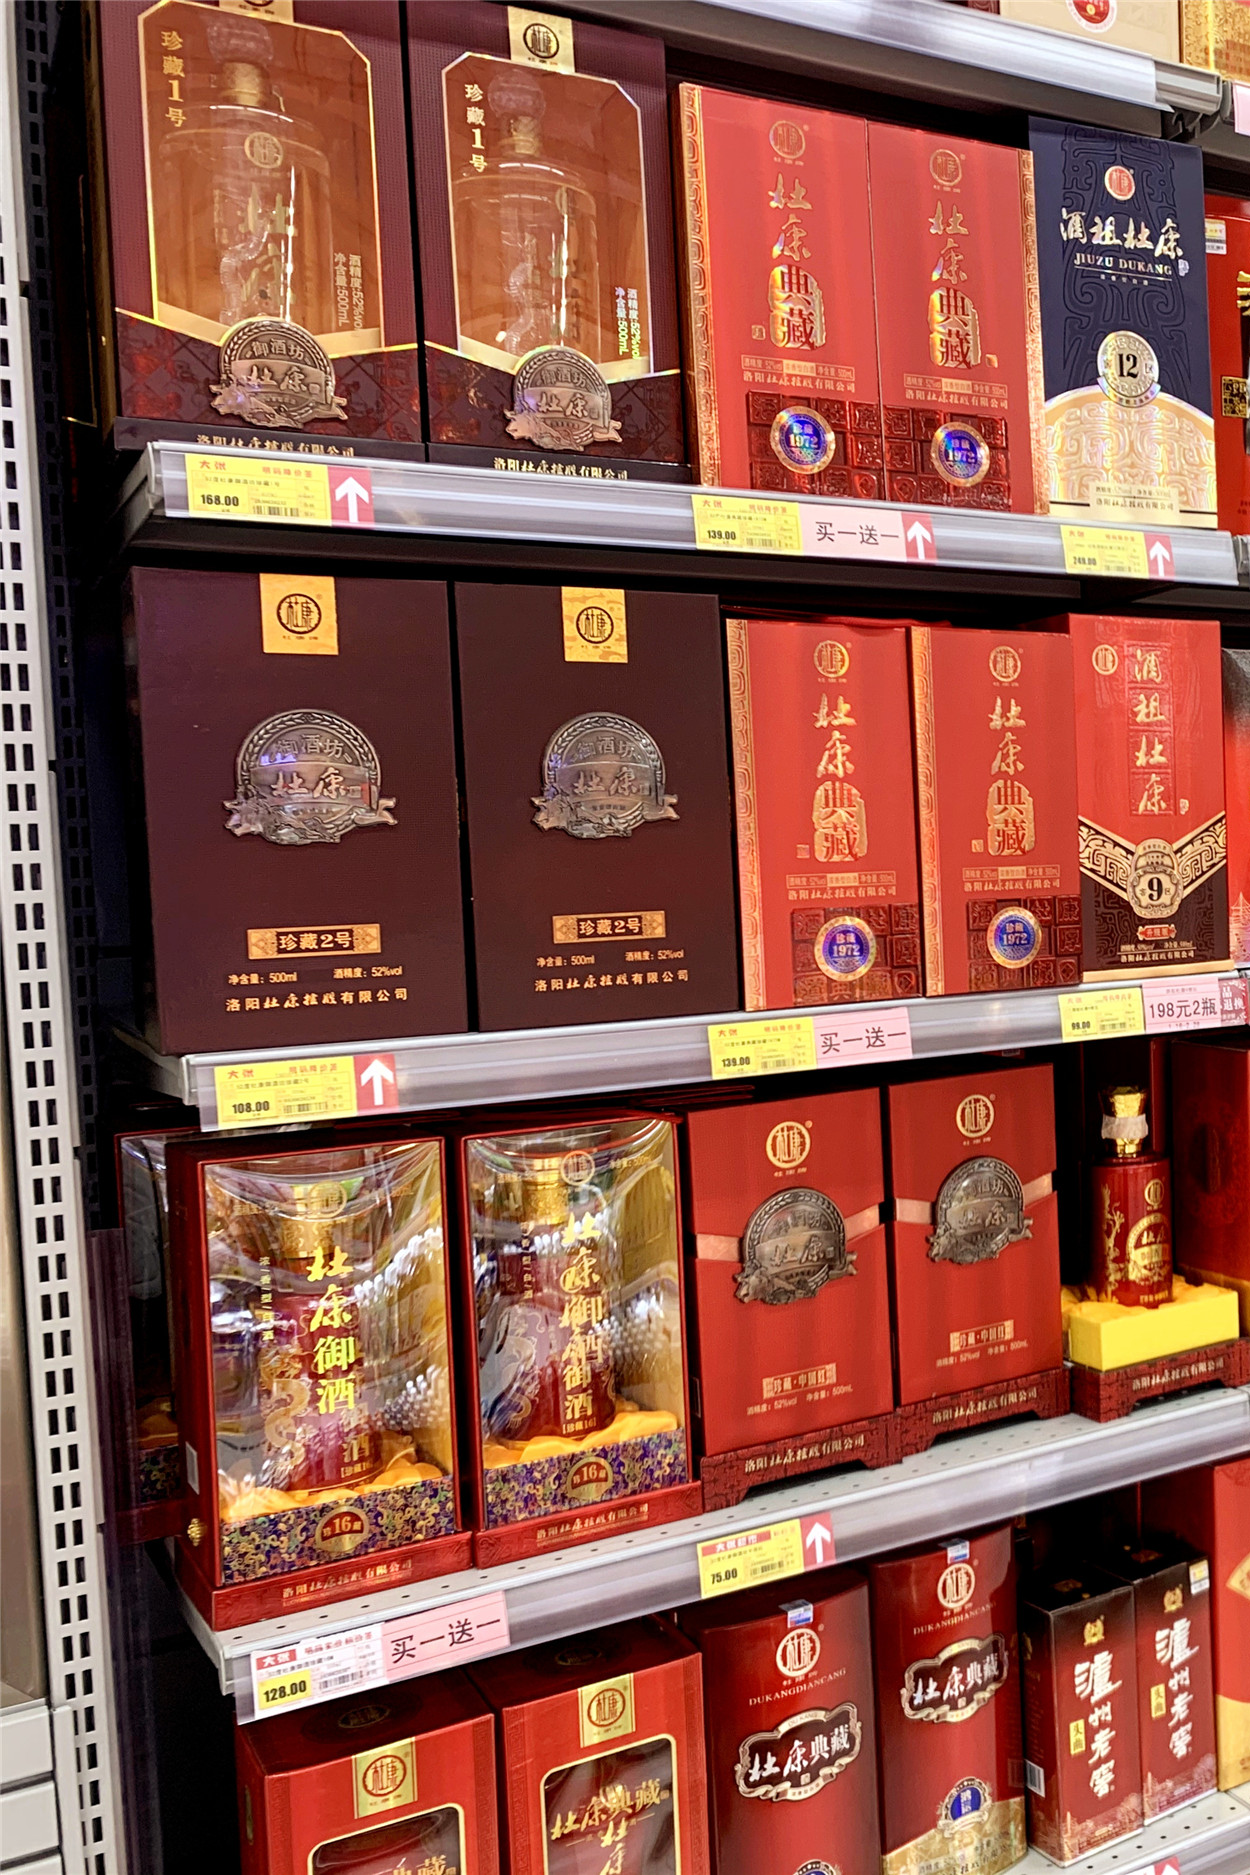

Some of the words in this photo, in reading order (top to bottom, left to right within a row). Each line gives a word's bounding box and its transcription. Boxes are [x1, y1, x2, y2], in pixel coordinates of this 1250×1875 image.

[161, 31, 188, 129] 珍藏1号
[465, 83, 489, 174] 珍藏1号
[768, 172, 814, 262] 杜康
[927, 199, 970, 285] 杜康
[1059, 206, 1185, 260] 酒祖杜康
[1073, 252, 1114, 268] JIUZU
[1118, 256, 1173, 276] DUKANG
[778, 263, 820, 350] 典藏
[937, 286, 972, 369] 典藏
[249, 364, 308, 392] 杜康
[1117, 353, 1138, 378] 12
[537, 392, 590, 418] 杜康
[201, 494, 240, 507] 168.00
[707, 529, 737, 542] 139.00
[815, 521, 900, 546] 买一送一
[812, 692, 857, 779] 杜康
[988, 695, 1027, 777] 杜康
[1133, 648, 1168, 815] 酒祖杜康
[270, 766, 348, 800] 杜康
[573, 766, 638, 797] 杜康
[819, 782, 859, 862] 典藏
[992, 783, 1027, 857] 典藏
[1147, 875, 1164, 902] 9
[278, 930, 353, 951] 珍藏2号
[578, 917, 641, 936] 珍藏2号
[1001, 932, 1029, 946] 1972
[831, 943, 862, 957] 1972
[534, 968, 690, 993] 洛阳杜康控股有限公司
[225, 987, 409, 1012] 洛阳杜康控股有限公司
[1150, 997, 1218, 1019] 198元2瓶
[1071, 1021, 1091, 1030] 99.00
[820, 1027, 907, 1055] 买一送一
[722, 1056, 751, 1068] 139.00
[232, 1100, 270, 1115] 108.00
[306, 1245, 356, 1415] 杜康御酒
[710, 1568, 738, 1584] 75.00
[390, 1617, 501, 1665] 买一送一
[262, 1648, 291, 1668] 大张
[263, 1680, 308, 1704] 128.00
[912, 1652, 1000, 1706] 杜康典藏
[1154, 1617, 1199, 1760] 泸州老窖
[1074, 1649, 1123, 1799] 泸州老窖
[748, 1723, 851, 1782] 杜康典藏
